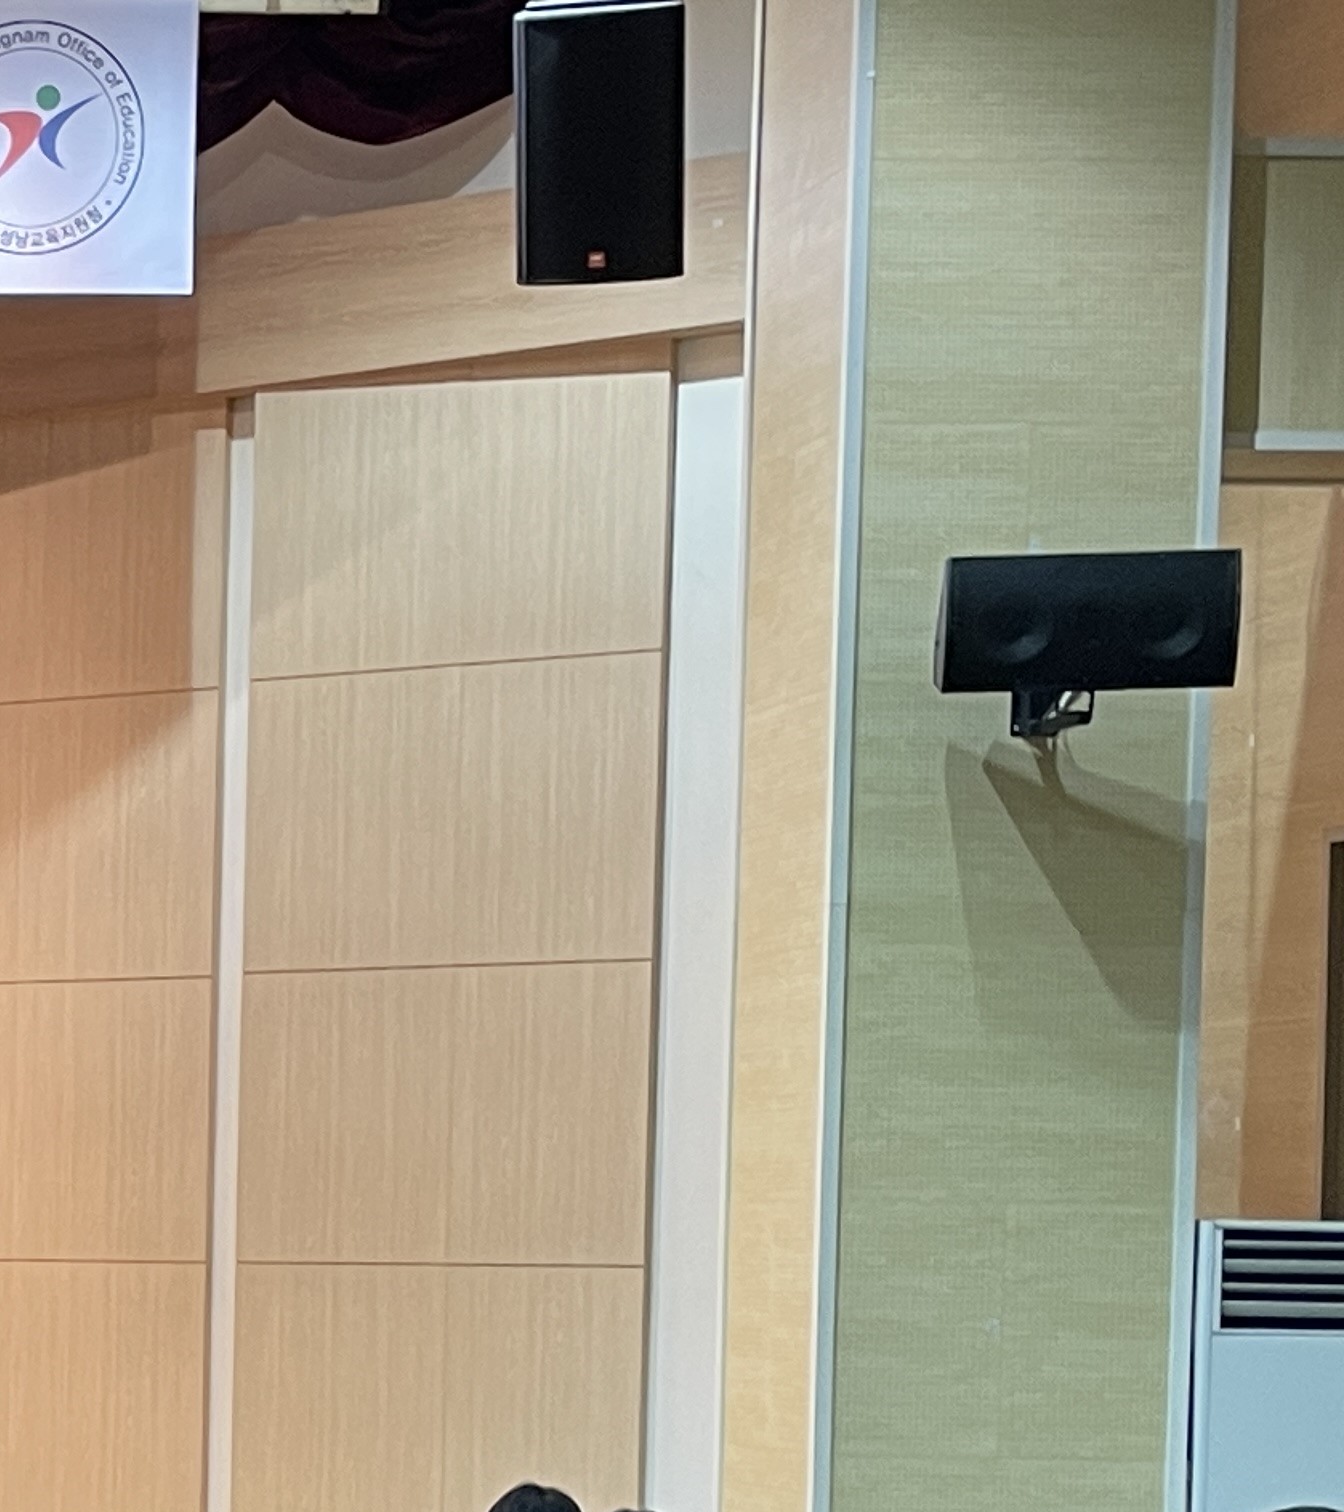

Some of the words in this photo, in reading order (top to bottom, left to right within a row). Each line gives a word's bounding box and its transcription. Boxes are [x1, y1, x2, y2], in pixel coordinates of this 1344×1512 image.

[57, 32, 105, 70] Office
[104, 70, 124, 89] of
[113, 91, 136, 186] Education
